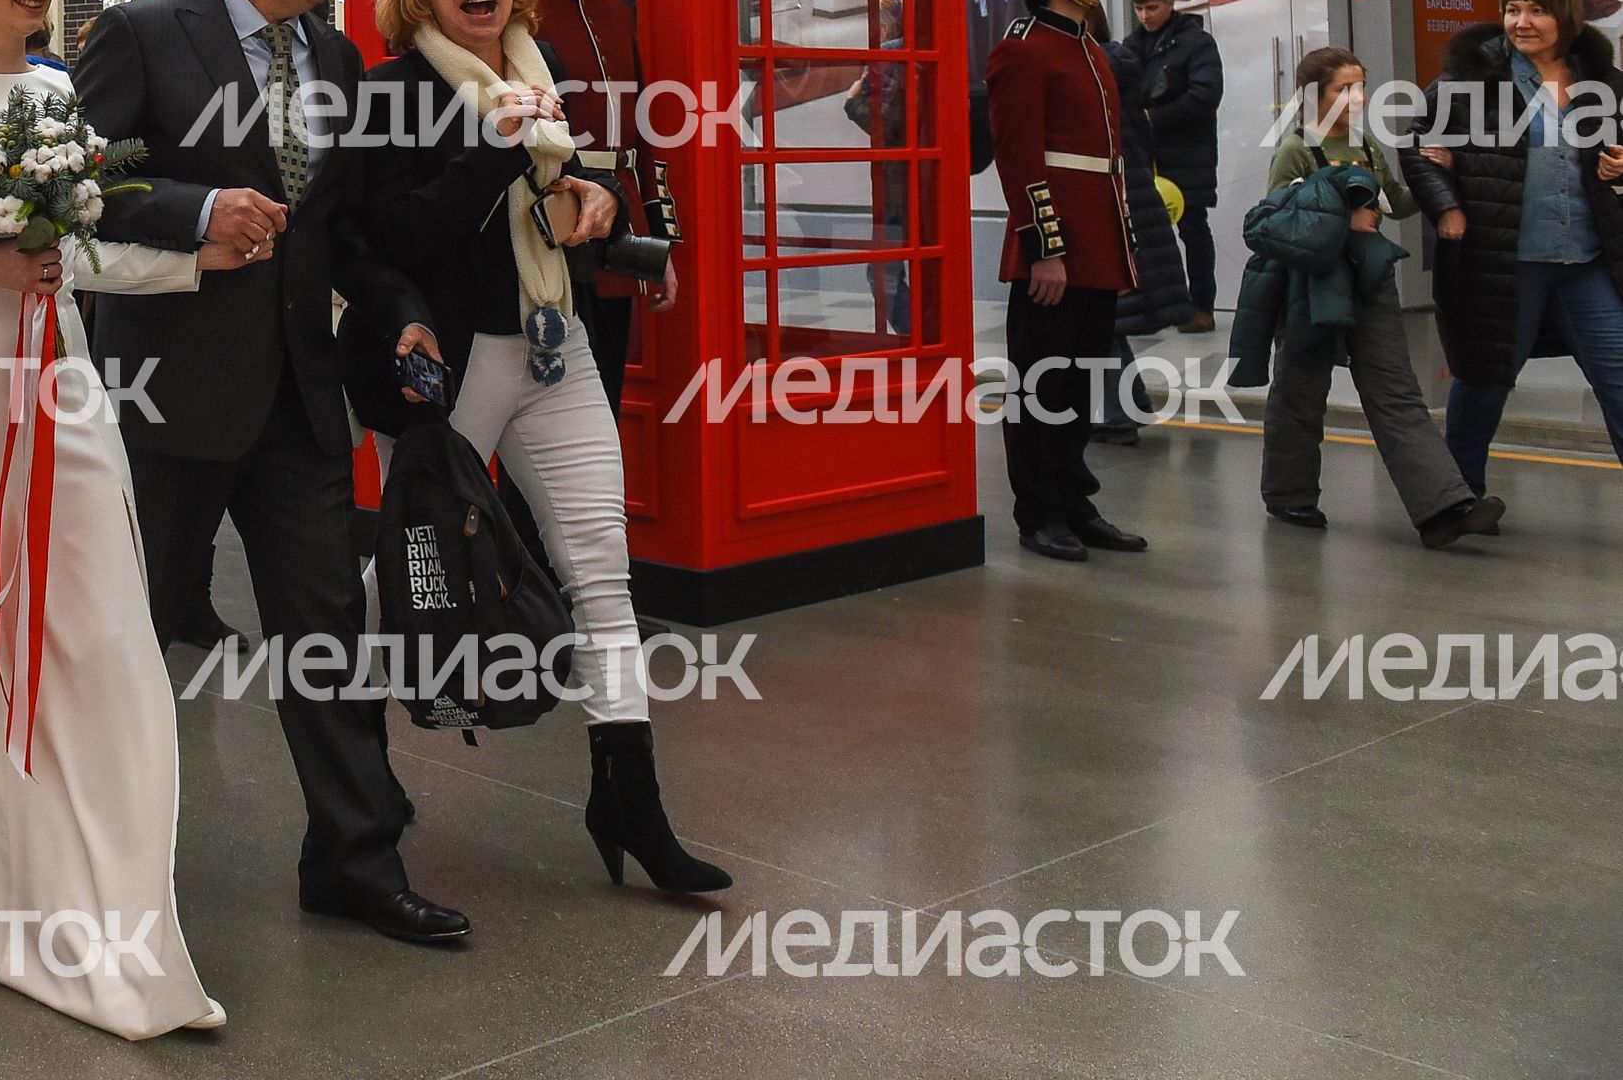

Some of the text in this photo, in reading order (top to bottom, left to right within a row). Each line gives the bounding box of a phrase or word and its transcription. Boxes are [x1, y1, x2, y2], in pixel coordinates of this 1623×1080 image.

[408, 558, 446, 576] RIAN.
[410, 575, 449, 593] RUCK
[412, 592, 458, 610] SACK.
[431, 707, 468, 717] SPECIAL
